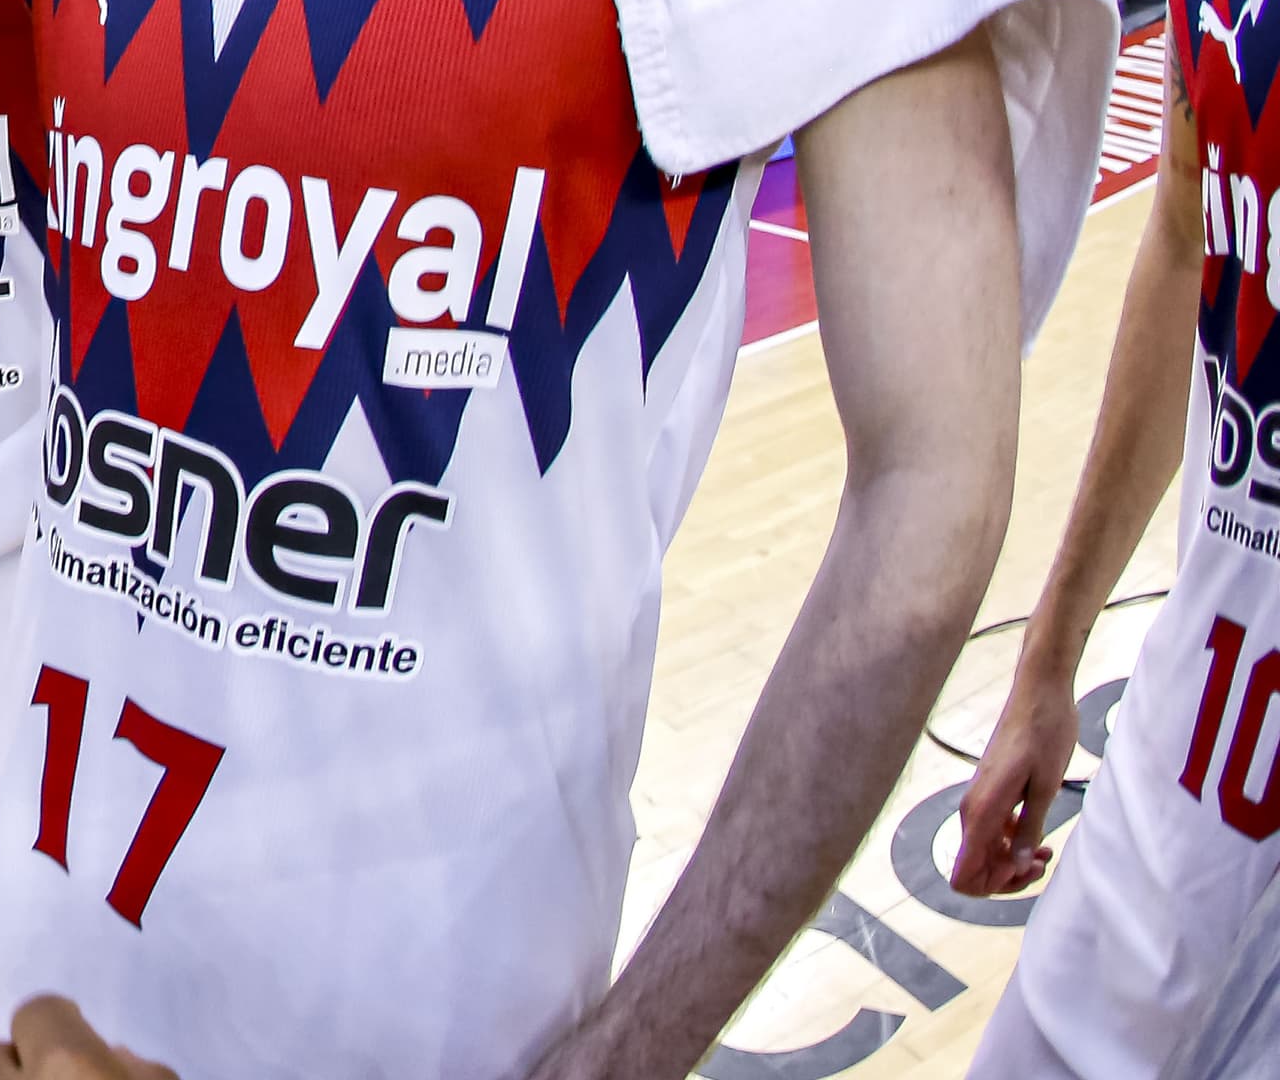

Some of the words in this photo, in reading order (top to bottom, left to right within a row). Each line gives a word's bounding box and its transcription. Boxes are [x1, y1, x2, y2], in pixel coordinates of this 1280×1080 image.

[394, 340, 493, 378] .media
[42, 395, 451, 610] osner
[1207, 505, 1280, 561] Climati
[233, 617, 418, 675] eficiente
[30, 663, 227, 931] 17
